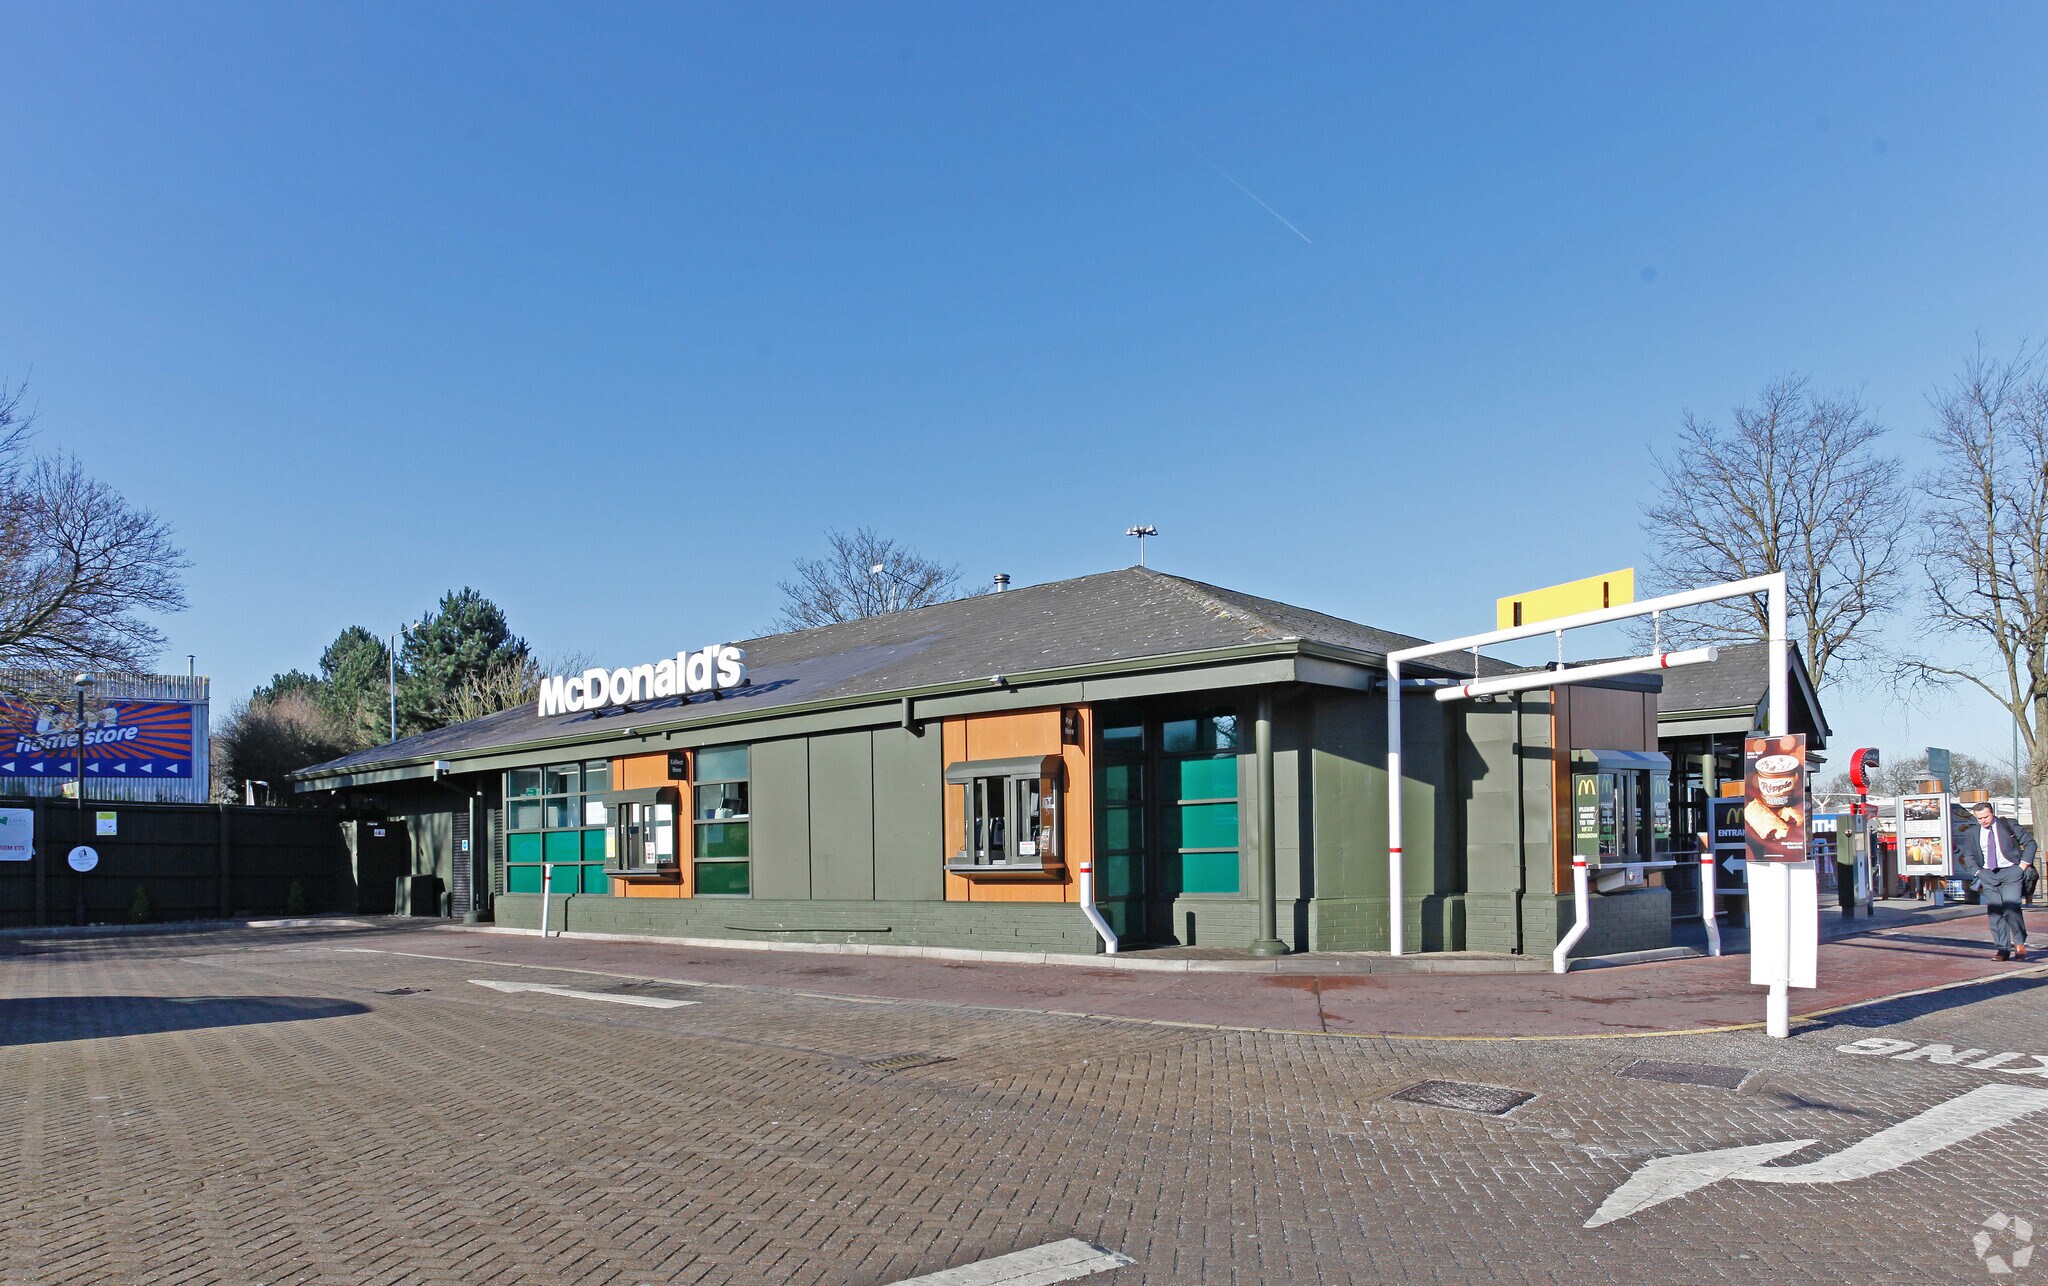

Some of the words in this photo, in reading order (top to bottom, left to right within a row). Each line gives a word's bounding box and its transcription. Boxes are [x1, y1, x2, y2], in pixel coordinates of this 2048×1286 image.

[538, 644, 745, 717] McDonald's
[1065, 717, 1073, 725] Pay
[1761, 781, 1792, 793] Ripple
